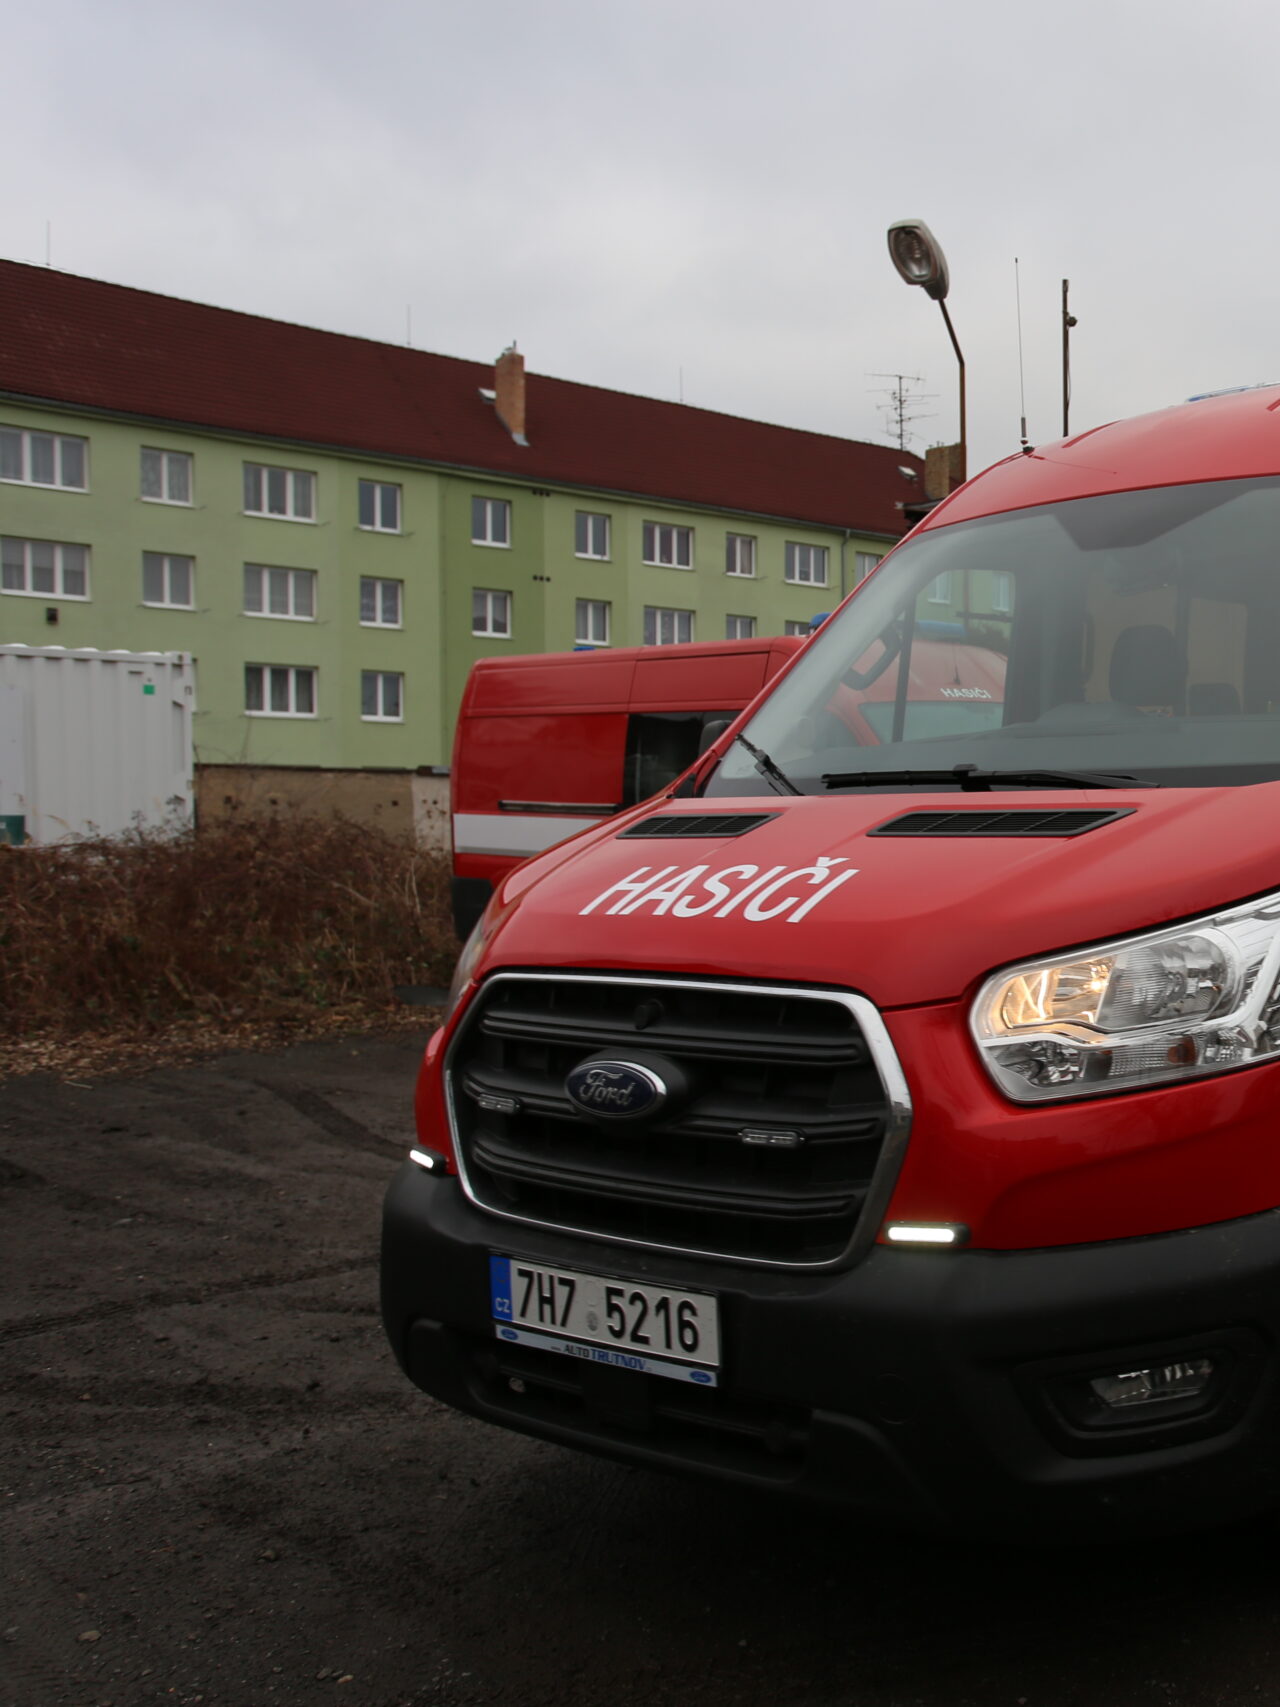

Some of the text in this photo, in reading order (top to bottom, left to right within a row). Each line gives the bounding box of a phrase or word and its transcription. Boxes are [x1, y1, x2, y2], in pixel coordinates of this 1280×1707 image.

[577, 856, 861, 924] HASIČI
[578, 1069, 636, 1107] Ford
[495, 1297, 511, 1313] CZ
[516, 1267, 700, 1354] 7H7 5216
